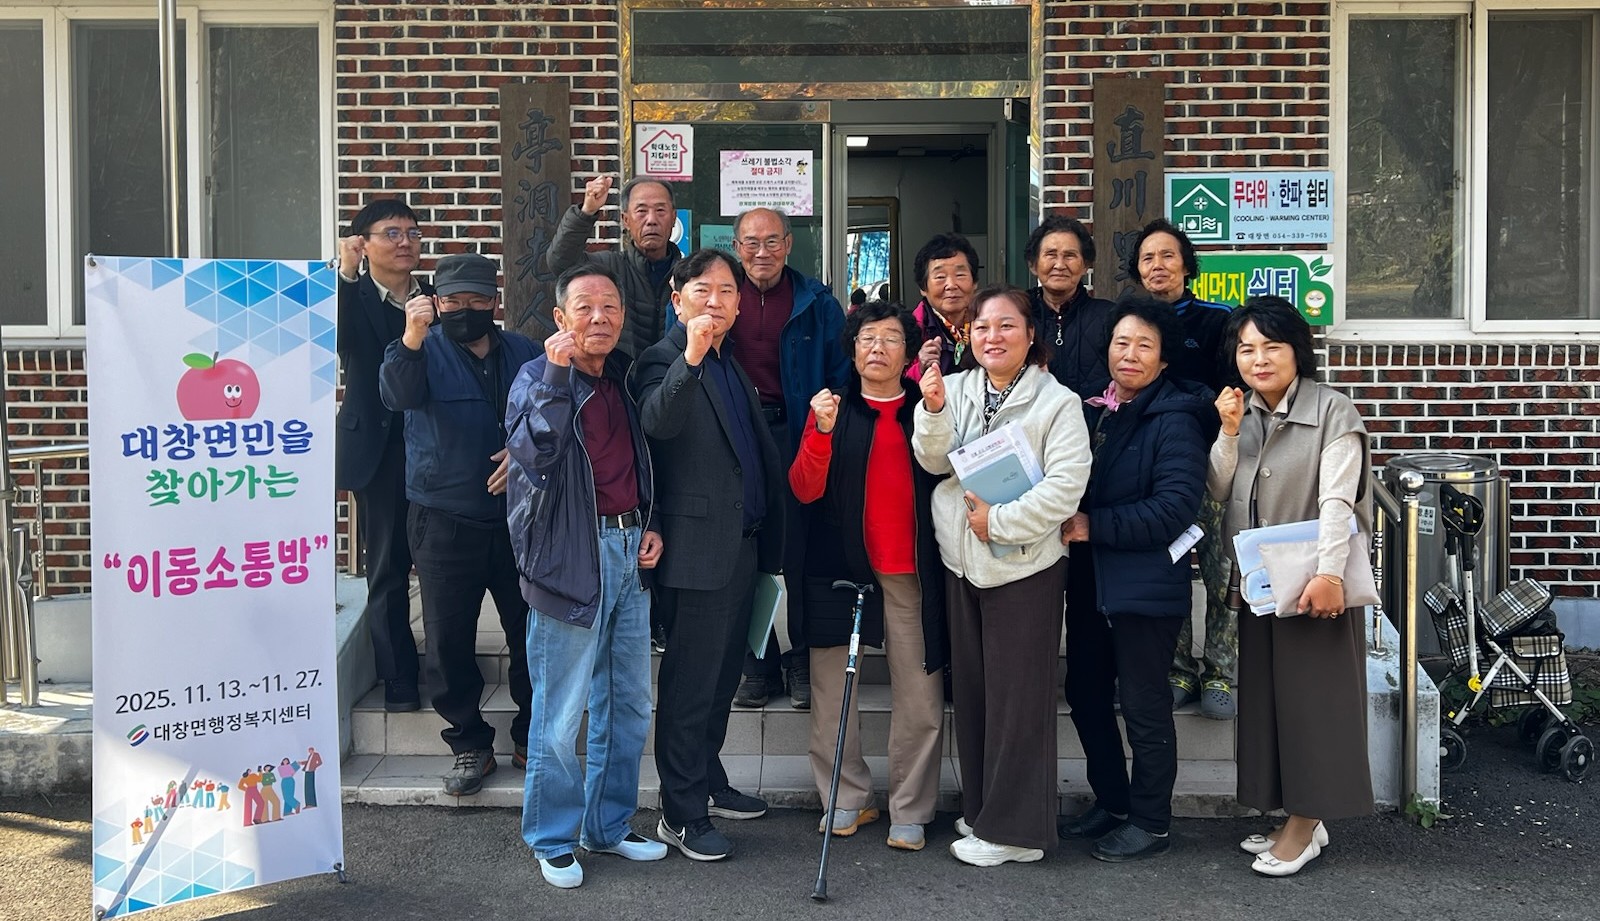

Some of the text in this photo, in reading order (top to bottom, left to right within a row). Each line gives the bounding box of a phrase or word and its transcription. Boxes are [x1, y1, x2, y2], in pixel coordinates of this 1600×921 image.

[741, 157, 792, 166] 쓰레기 불법소각
[751, 167, 765, 175] 절대
[1233, 179, 1268, 208] 무더위
[1279, 179, 1302, 208] 한파
[1306, 178, 1329, 208] 쉼터
[1233, 215, 1265, 223] (COOLING
[1269, 214, 1300, 222] WARMING
[1301, 214, 1330, 222] CENTER)
[1248, 232, 1270, 240] 대창면
[1191, 272, 1246, 307] 세먼지
[121, 419, 314, 461] 대창면민을
[146, 464, 299, 507] 찾아가는
[103, 534, 328, 598] “이동소통방”
[115, 689, 176, 714] 2025.
[184, 684, 211, 704] 11.
[295, 669, 322, 689] 27.
[153, 703, 311, 741] 대창면행정복지센터
